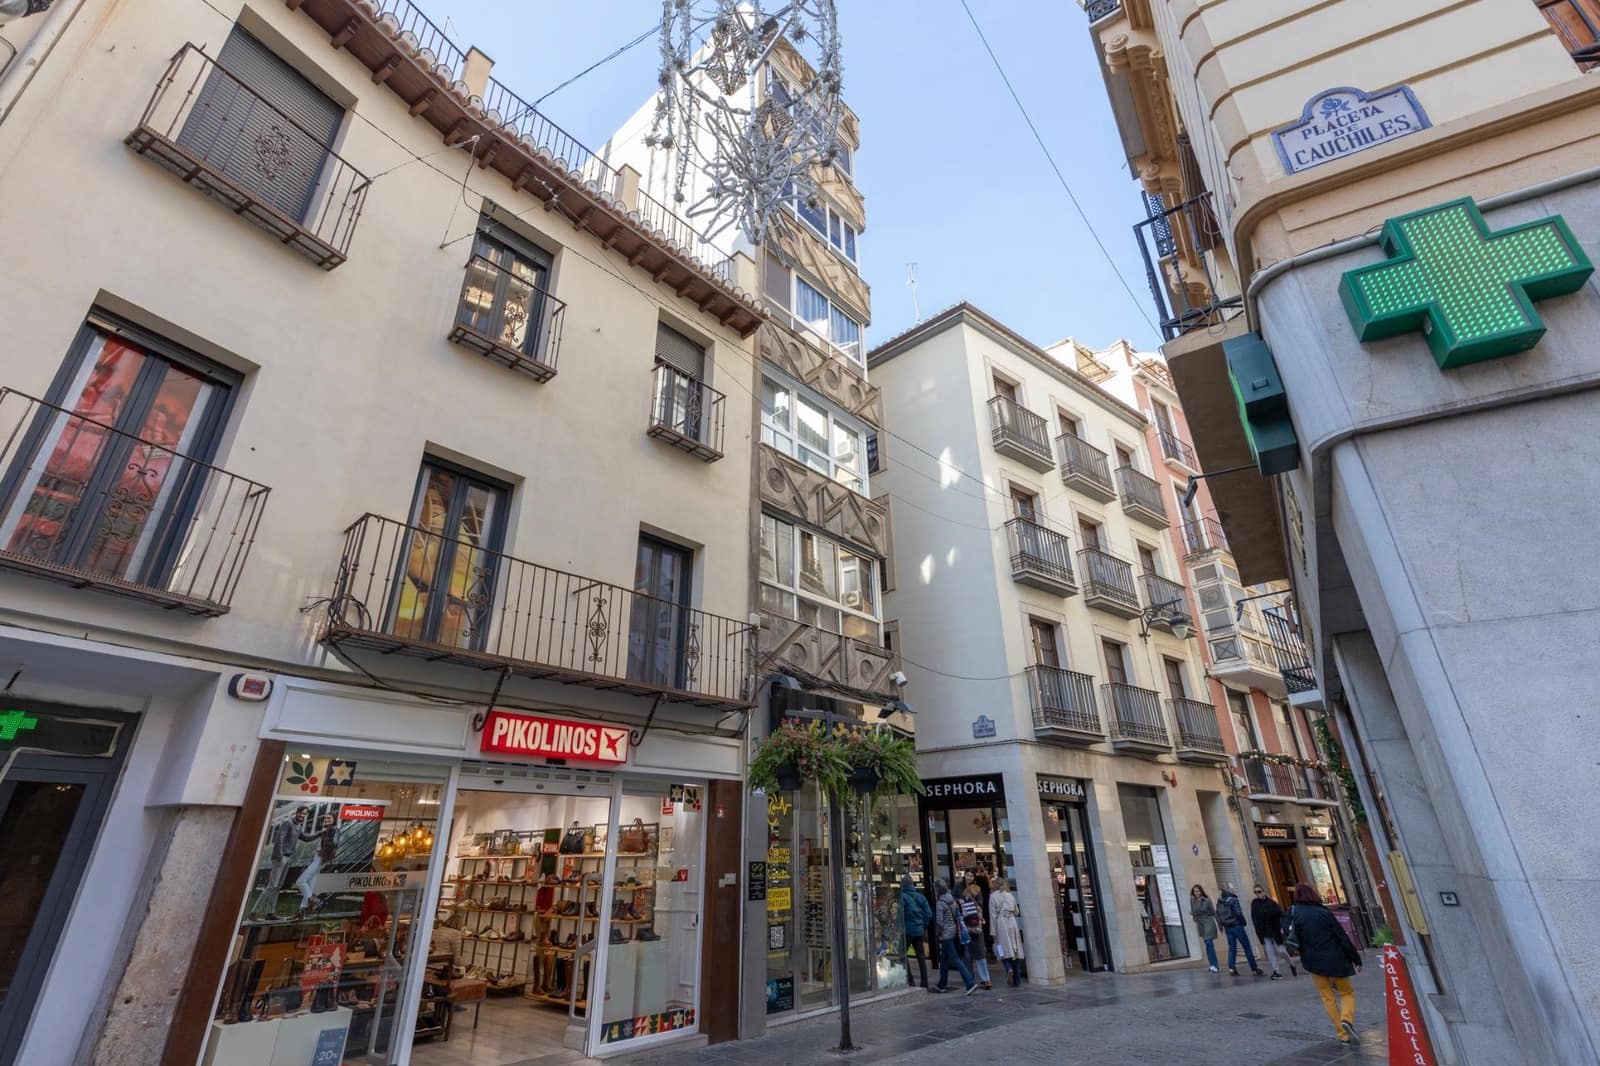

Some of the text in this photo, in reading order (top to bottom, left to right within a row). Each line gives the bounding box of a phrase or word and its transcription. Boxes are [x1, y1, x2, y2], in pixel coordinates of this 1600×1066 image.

[1301, 105, 1384, 140] PLACETA
[1334, 123, 1360, 137] DE
[1294, 114, 1411, 166] CAUCHILES
[491, 717, 598, 756] PIKOLINOS
[927, 781, 996, 797] SEPHORA
[1038, 780, 1084, 796] SEPHORA
[345, 809, 379, 817] PIKOLINOS
[348, 876, 392, 888] PIKOLINOS
[1385, 962, 1427, 1066] argenta
